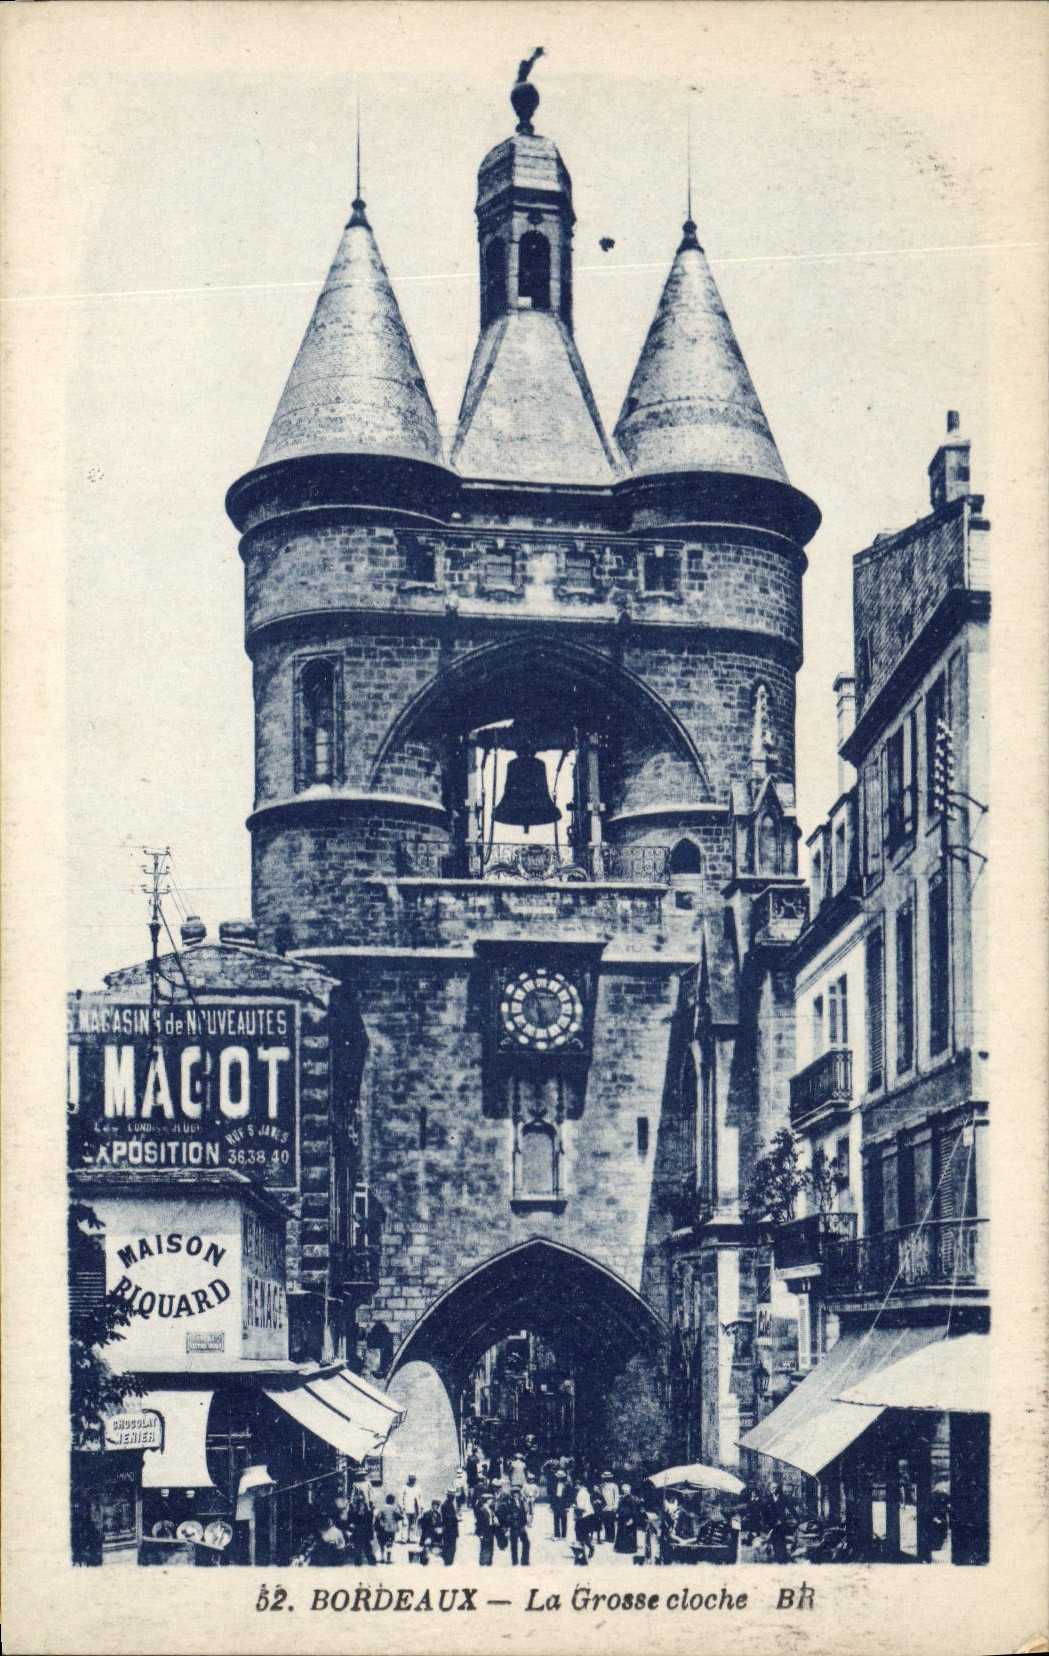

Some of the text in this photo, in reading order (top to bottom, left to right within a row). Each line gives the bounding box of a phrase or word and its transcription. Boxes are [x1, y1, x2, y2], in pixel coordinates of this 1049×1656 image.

[165, 1012, 183, 1035] de
[103, 1045, 291, 1120] MAGOT
[116, 1233, 227, 1269] MAISON
